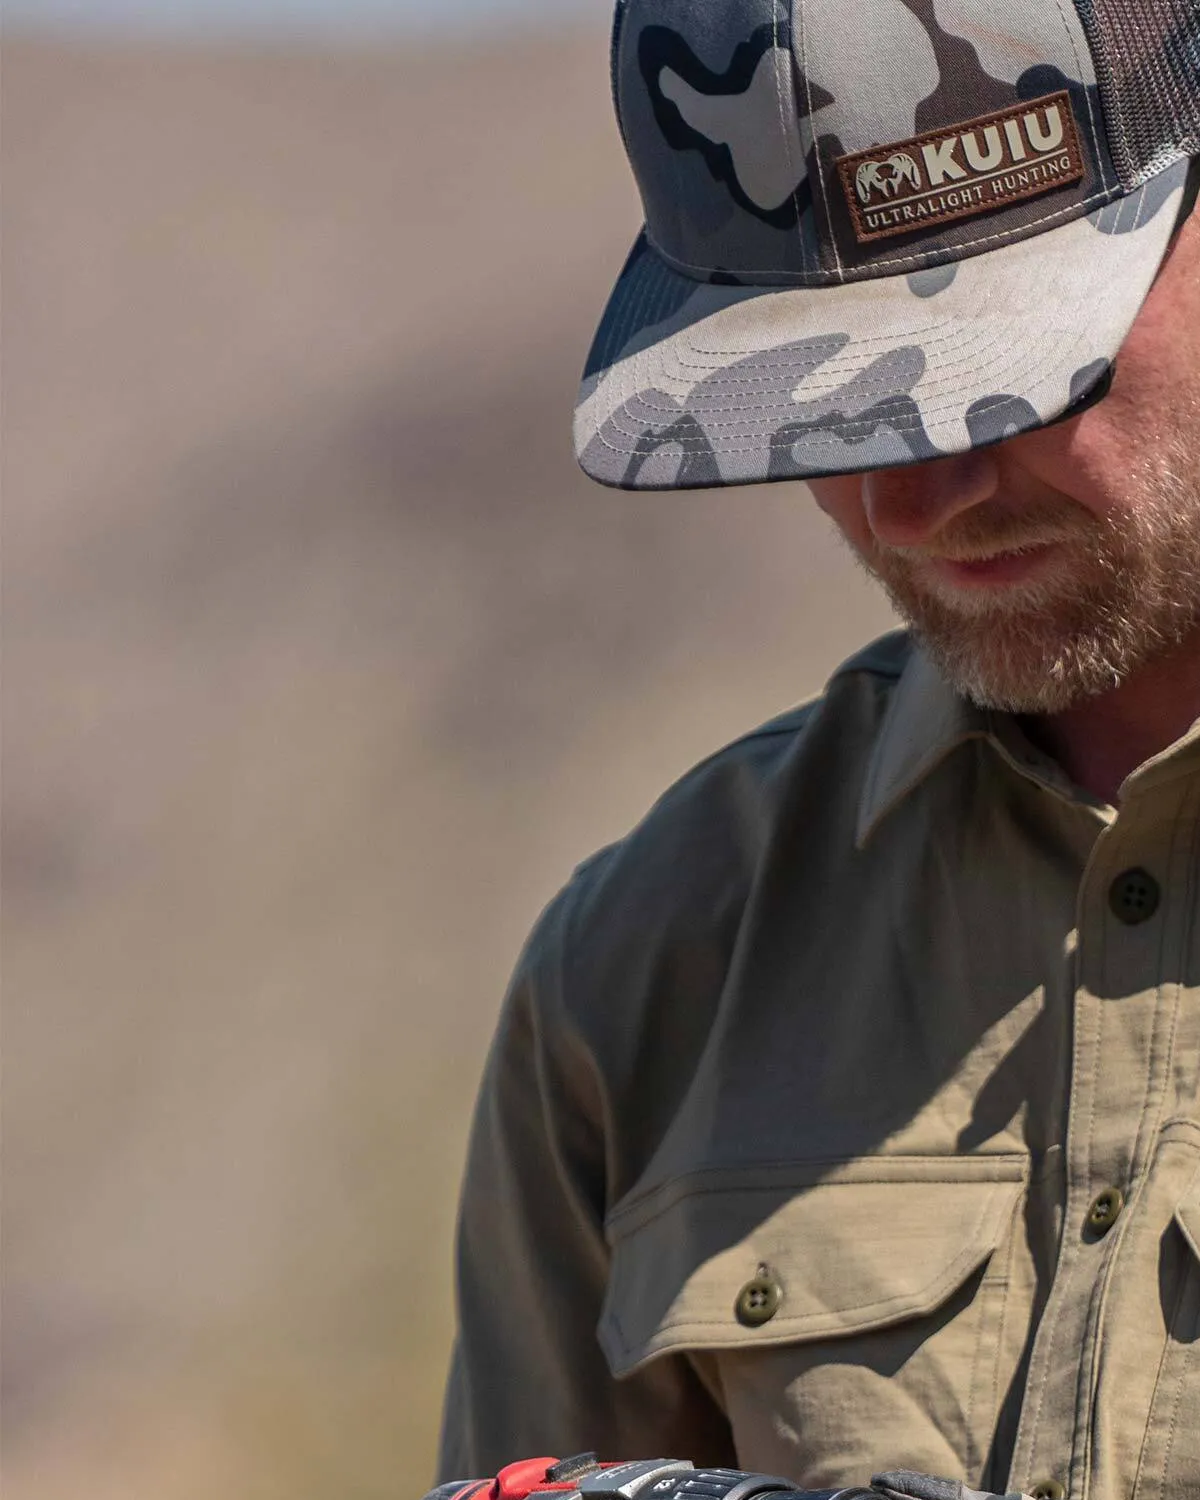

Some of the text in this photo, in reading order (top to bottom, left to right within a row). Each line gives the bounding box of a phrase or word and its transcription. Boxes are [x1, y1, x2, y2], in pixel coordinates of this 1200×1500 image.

[921, 106, 1064, 187] KUIU
[866, 157, 1071, 229] ULTRALIGHT HUNTING
